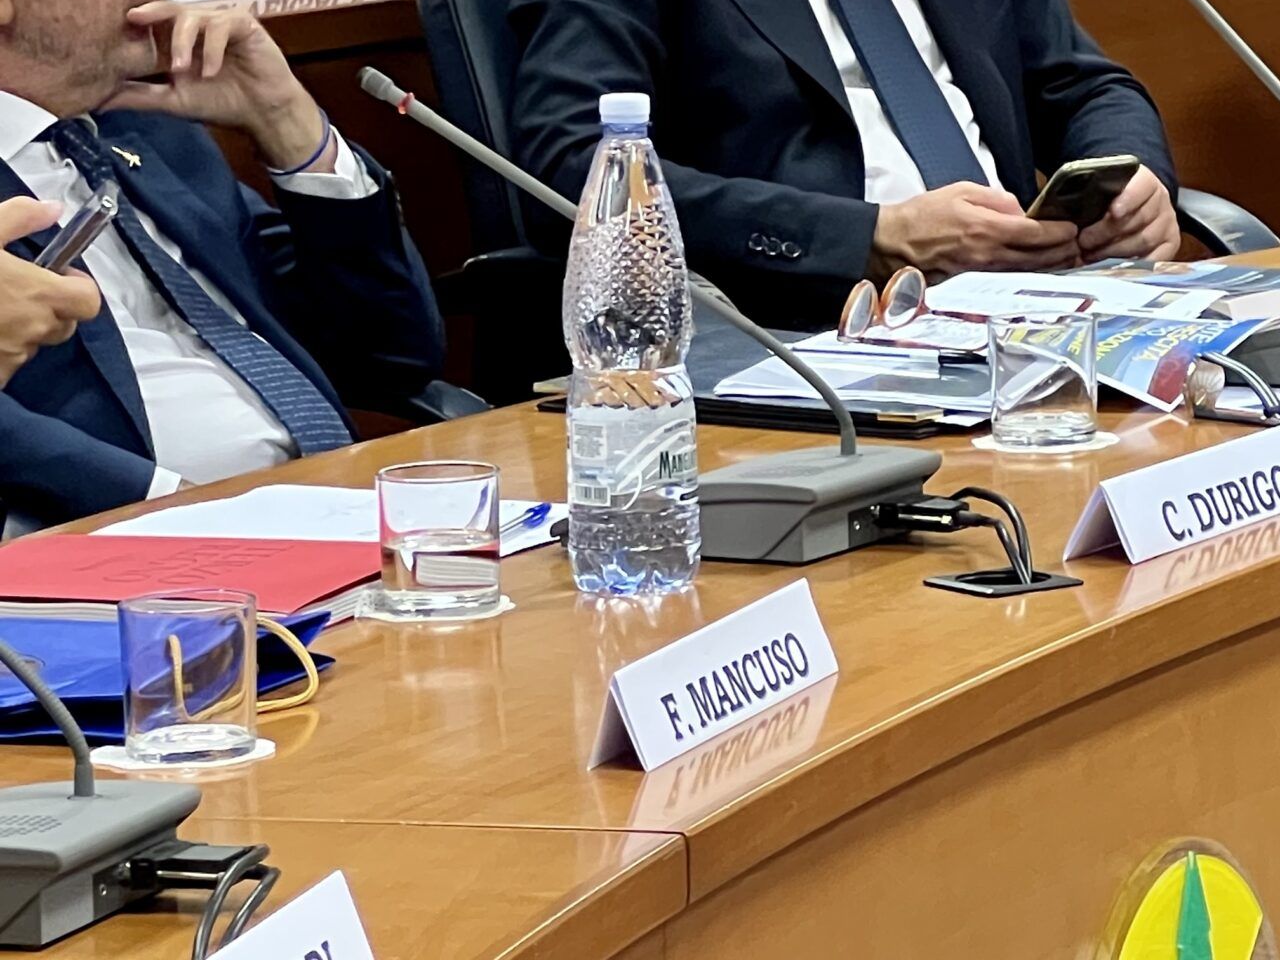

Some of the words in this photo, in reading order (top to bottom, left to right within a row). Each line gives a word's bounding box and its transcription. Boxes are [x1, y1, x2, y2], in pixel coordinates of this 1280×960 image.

[1162, 500, 1194, 542] C.
[660, 692, 696, 740] F.
[685, 632, 810, 728] MANCUSO
